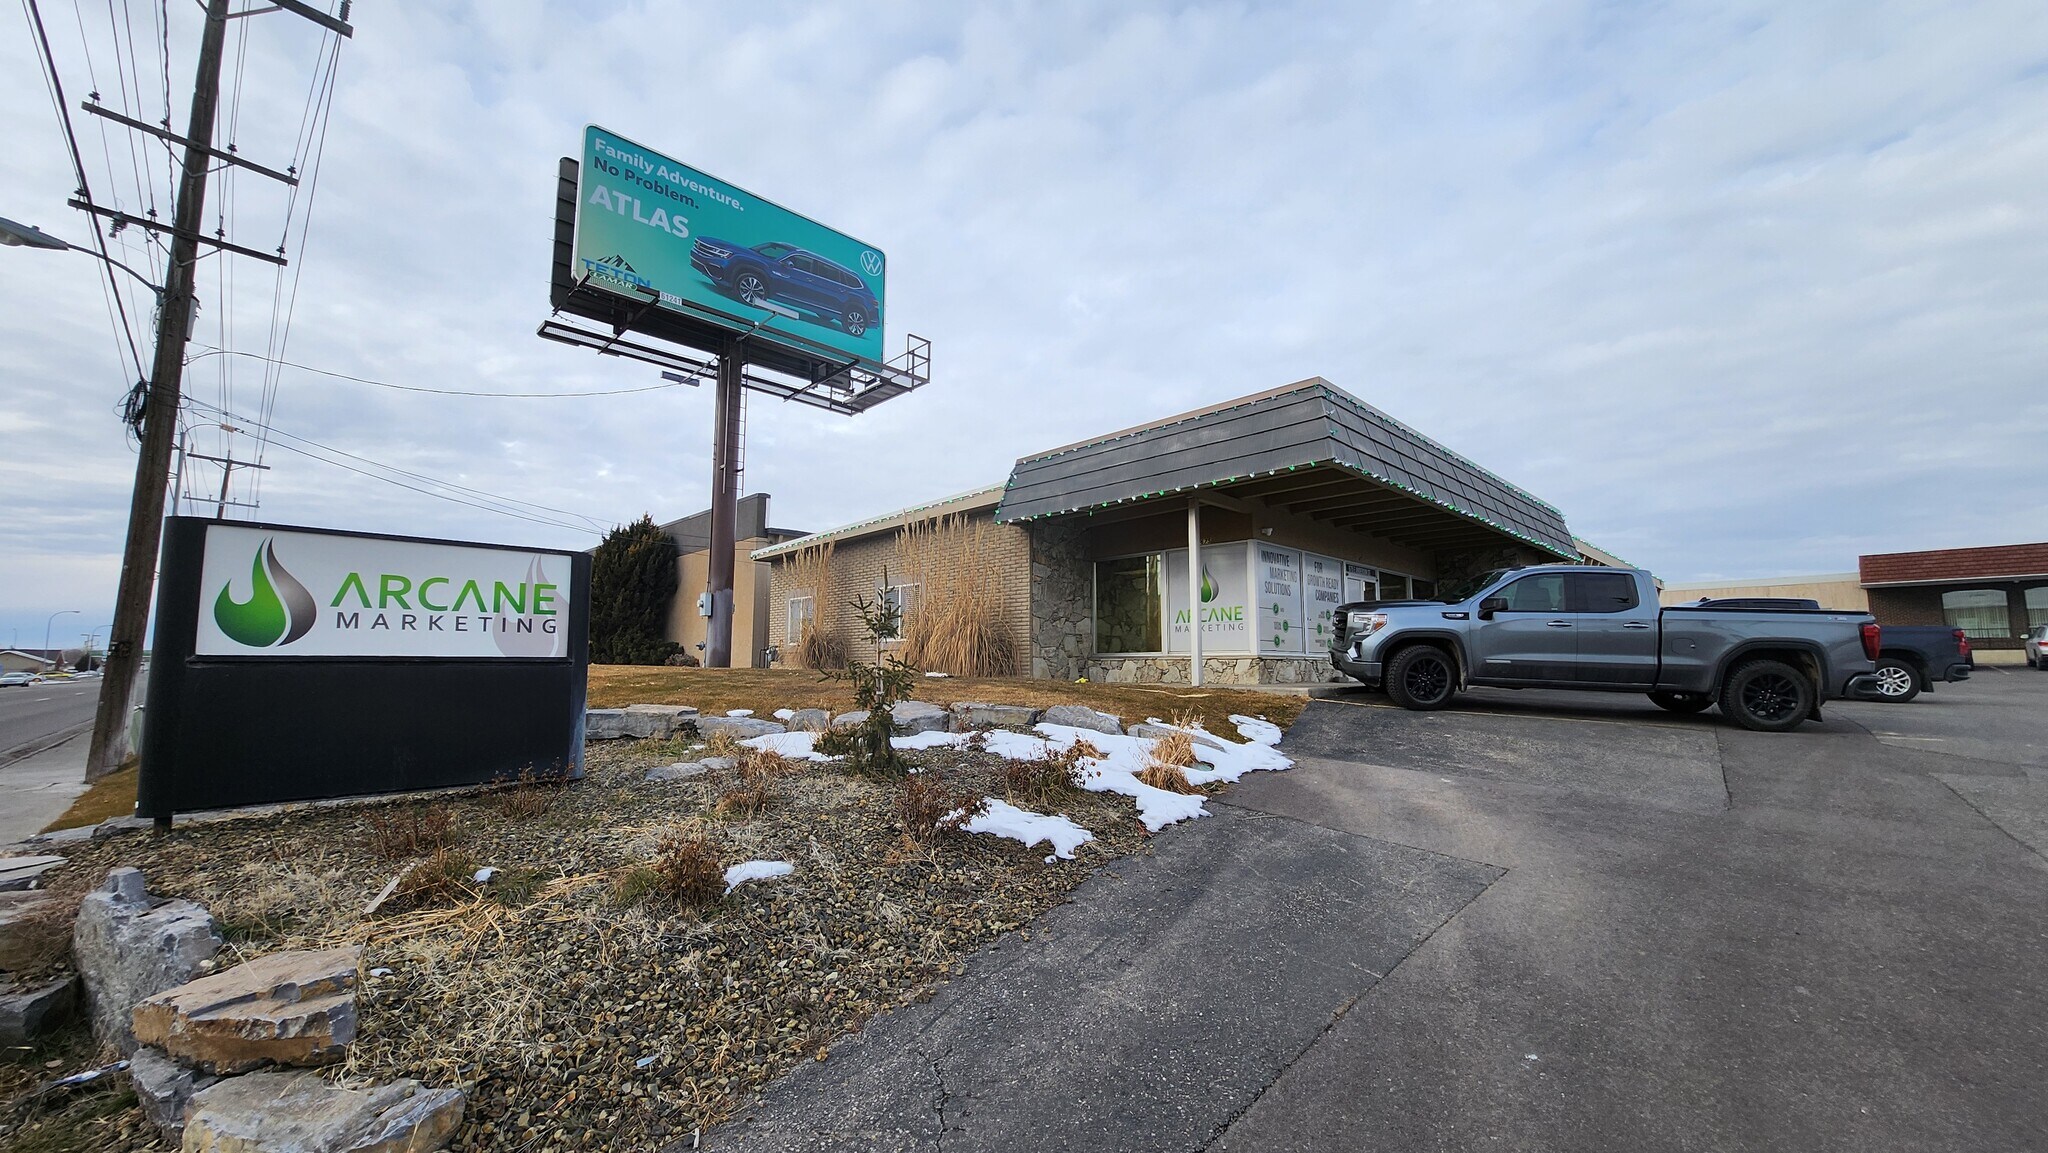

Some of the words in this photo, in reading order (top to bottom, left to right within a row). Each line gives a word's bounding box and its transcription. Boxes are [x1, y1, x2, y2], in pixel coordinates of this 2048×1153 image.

[594, 138, 654, 175] Family
[656, 165, 745, 212] Adventure.
[594, 156, 620, 177] No
[624, 168, 699, 209] Problem.
[588, 184, 689, 238] ATLAS
[581, 258, 651, 289] TETON
[592, 271, 634, 290] LAMAR
[660, 291, 682, 304] 61241
[1261, 549, 1290, 567] INNOVATIVE
[1269, 566, 1298, 583] MARKETING
[1314, 561, 1323, 574] FOR
[1264, 580, 1292, 597] SOLUTIONS
[1325, 576, 1339, 590] READY
[329, 571, 558, 616] ARCANE
[1315, 589, 1339, 604] COMPANIES
[335, 611, 557, 634] MARKETING
[1175, 605, 1244, 624] ACANE
[1174, 622, 1244, 633] MAKETING
